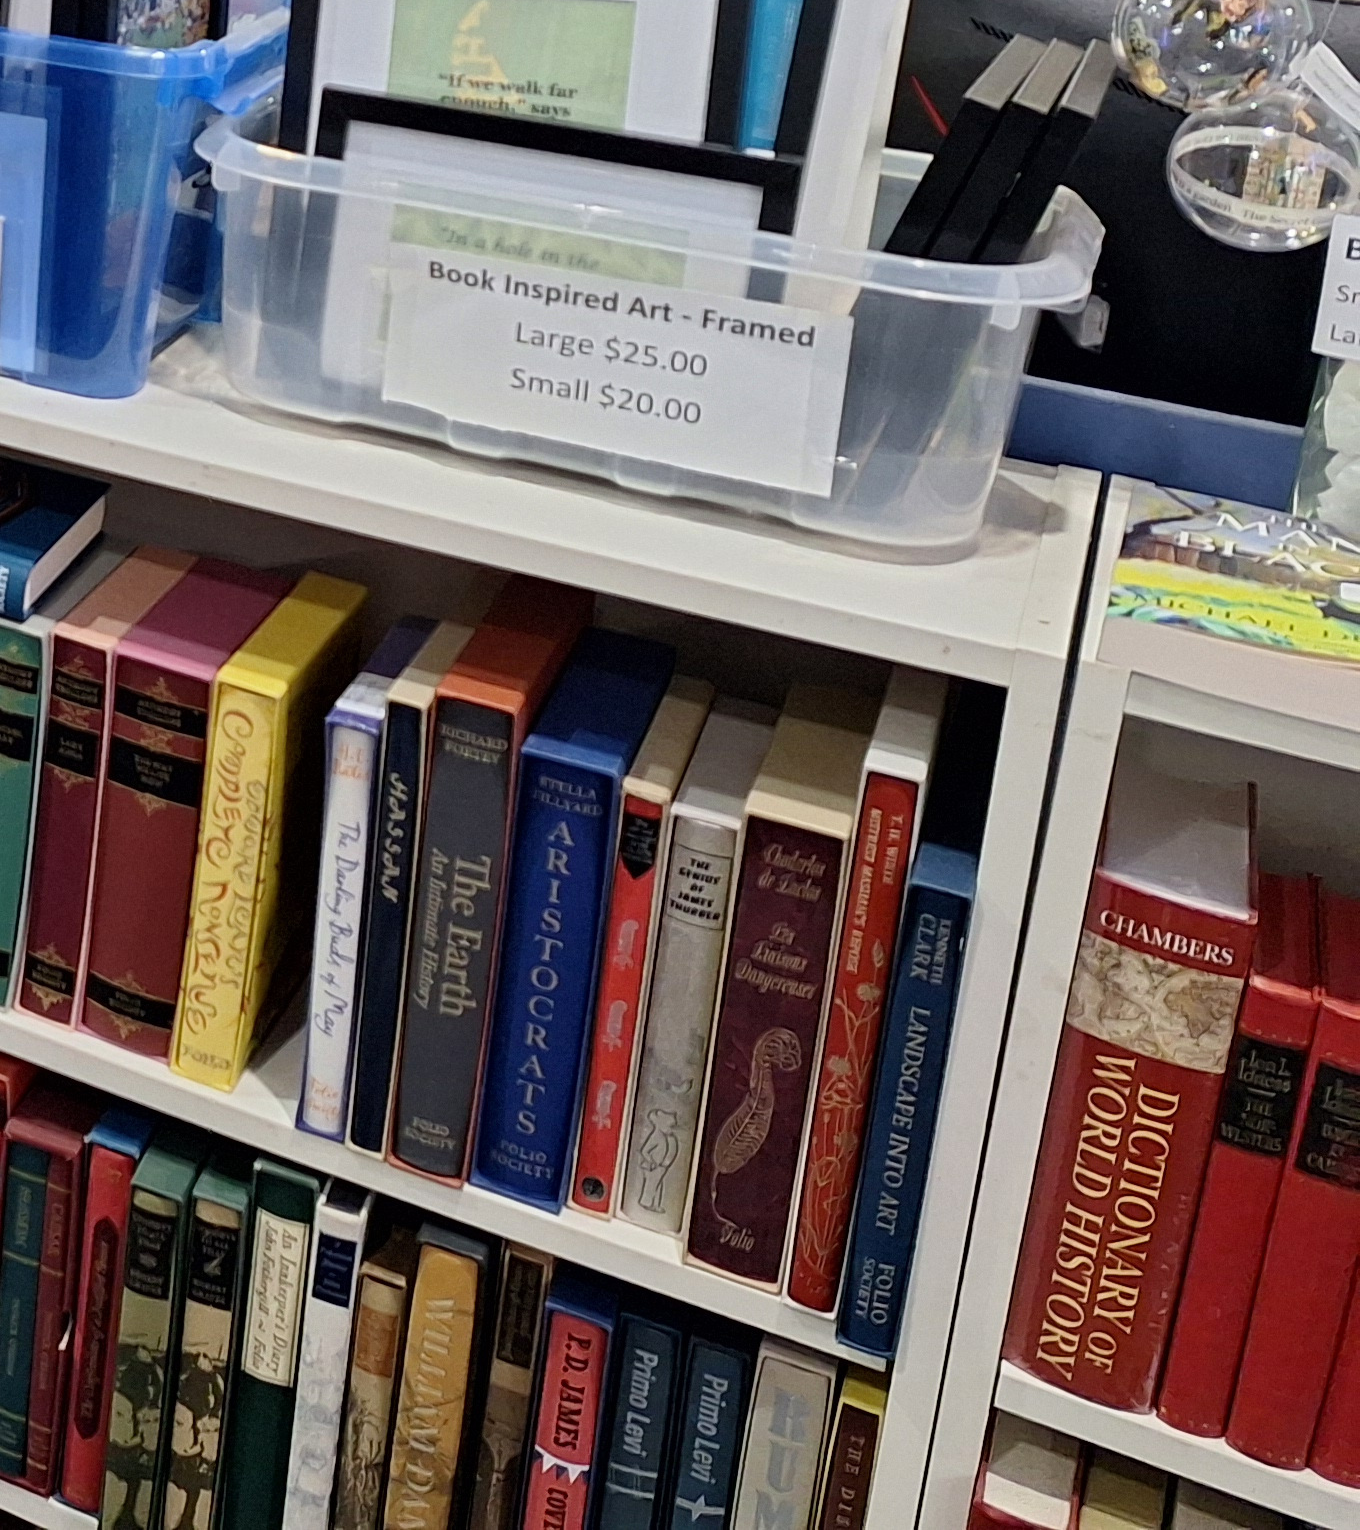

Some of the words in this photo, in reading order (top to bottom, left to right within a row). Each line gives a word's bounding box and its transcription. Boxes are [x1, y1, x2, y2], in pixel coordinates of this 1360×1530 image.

[472, 80, 493, 91] we
[496, 80, 544, 97] walk
[549, 85, 578, 99] far
[489, 237, 533, 263] hole
[428, 260, 494, 293] Book
[504, 273, 617, 314] Inspired
[626, 293, 673, 324] Art
[702, 308, 816, 348] Framed
[516, 321, 594, 360] Large
[605, 334, 707, 379] $25.00
[510, 368, 589, 405] Small
[598, 380, 702, 425] $20.00
[336, 820, 362, 850] The
[380, 772, 410, 905] HASSAN
[429, 848, 449, 872] An
[330, 854, 358, 916] Darling
[452, 855, 492, 919] The
[678, 867, 720, 886] GENIUS
[688, 858, 709, 872] THE
[689, 882, 705, 895] OF
[420, 877, 447, 952] Intimate
[668, 900, 721, 923] THURBER
[677, 890, 715, 909] JAMES
[325, 920, 351, 966] Buds
[908, 914, 938, 980] CLARK
[1100, 908, 1235, 967] CHAMBERS
[322, 974, 333, 991] of
[413, 955, 435, 1011] History
[439, 928, 483, 1018] Earth
[515, 819, 576, 1136] ARISTOCRATS
[312, 995, 348, 1038] May
[892, 1005, 933, 1128] LANDSCAPE
[1072, 1050, 1137, 1201] WORLD
[881, 1130, 911, 1190] INTO
[871, 1193, 898, 1236] ART
[1109, 1082, 1180, 1335] DICTIONARY
[720, 1224, 755, 1254] Folio
[869, 1263, 897, 1325] FOLIO
[1035, 1200, 1105, 1381] HISTORY
[566, 1331, 592, 1372] P.D.
[628, 1348, 659, 1409] Primo
[1083, 1329, 1117, 1376] OF
[553, 1379, 587, 1452] JAMES
[697, 1373, 729, 1434] Primo
[621, 1414, 652, 1456] Levi
[692, 1440, 720, 1483] Levi
